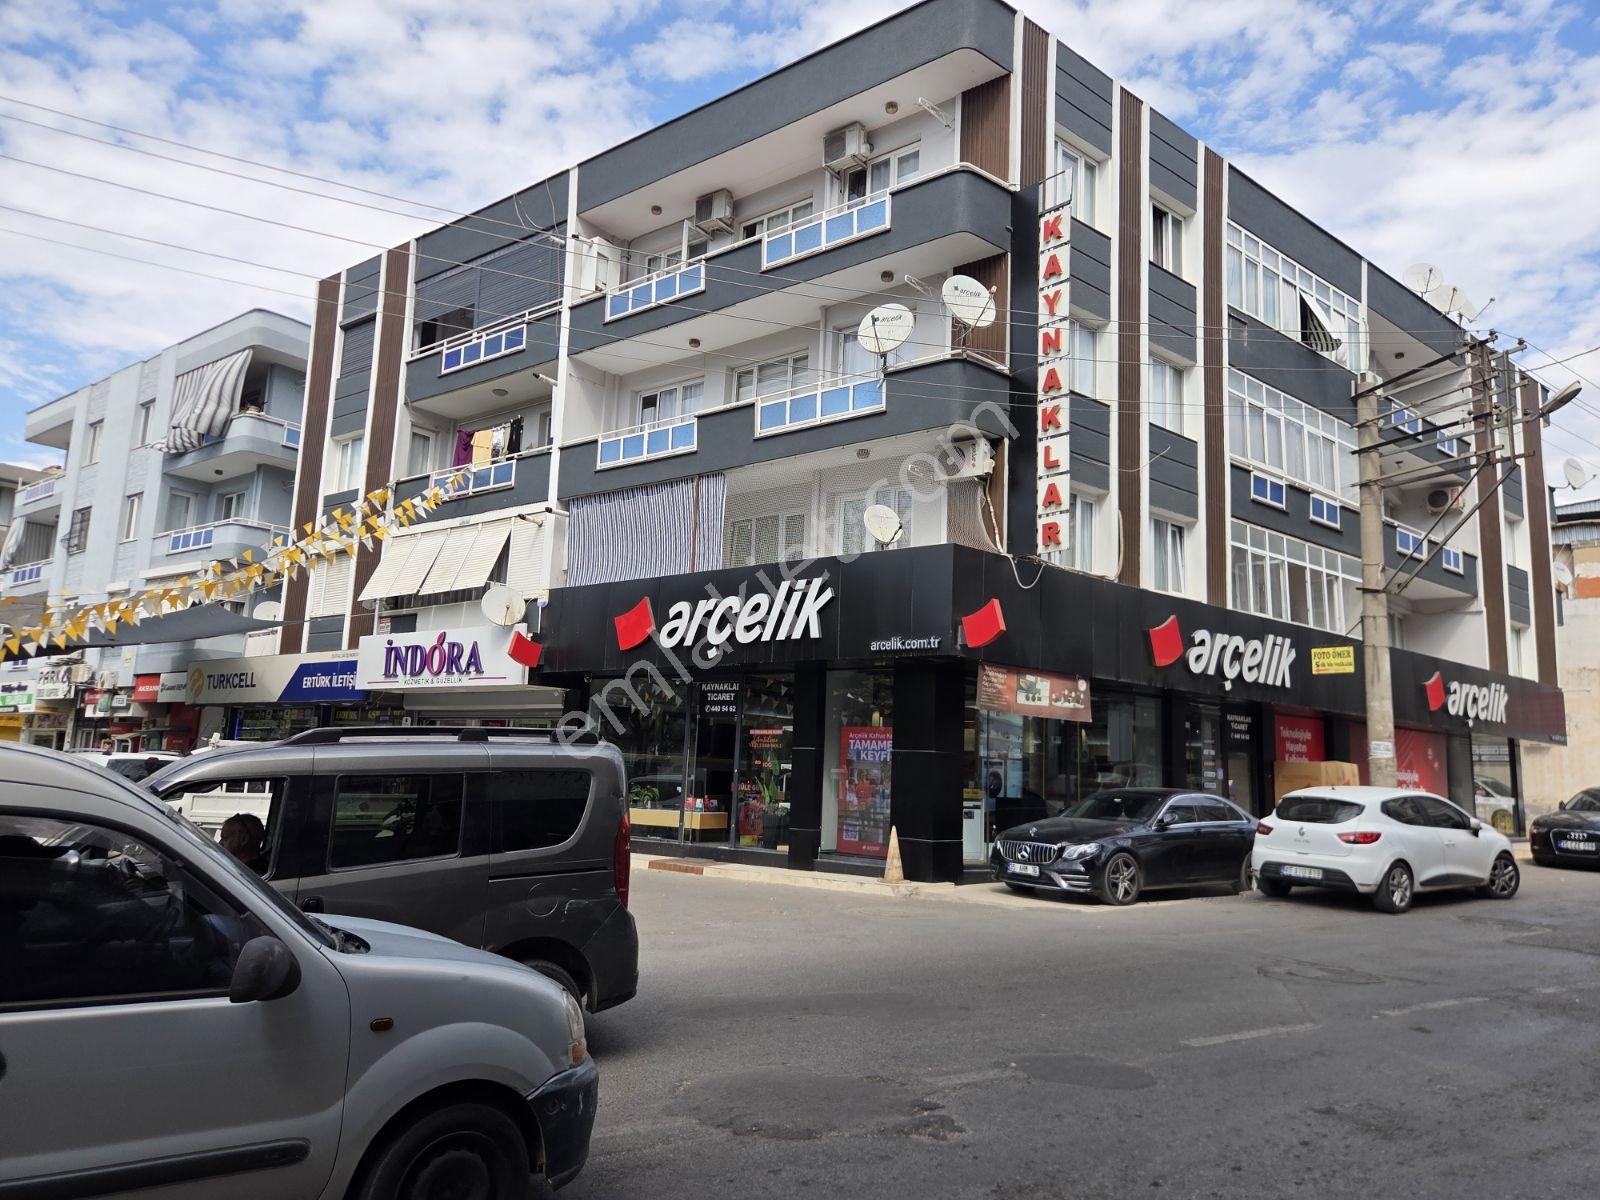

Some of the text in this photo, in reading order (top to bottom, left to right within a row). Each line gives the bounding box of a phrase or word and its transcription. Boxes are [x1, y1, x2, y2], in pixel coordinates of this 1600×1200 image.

[1042, 214, 1064, 546] KAYNAKLAR
[659, 577, 835, 660] arçelik
[870, 635, 942, 651] arcelik.com.tr
[1187, 629, 1297, 691] arçelik
[207, 672, 257, 690] TURKCELL
[302, 673, 331, 689] ERTÜRK
[1447, 681, 1509, 728] arçelik
